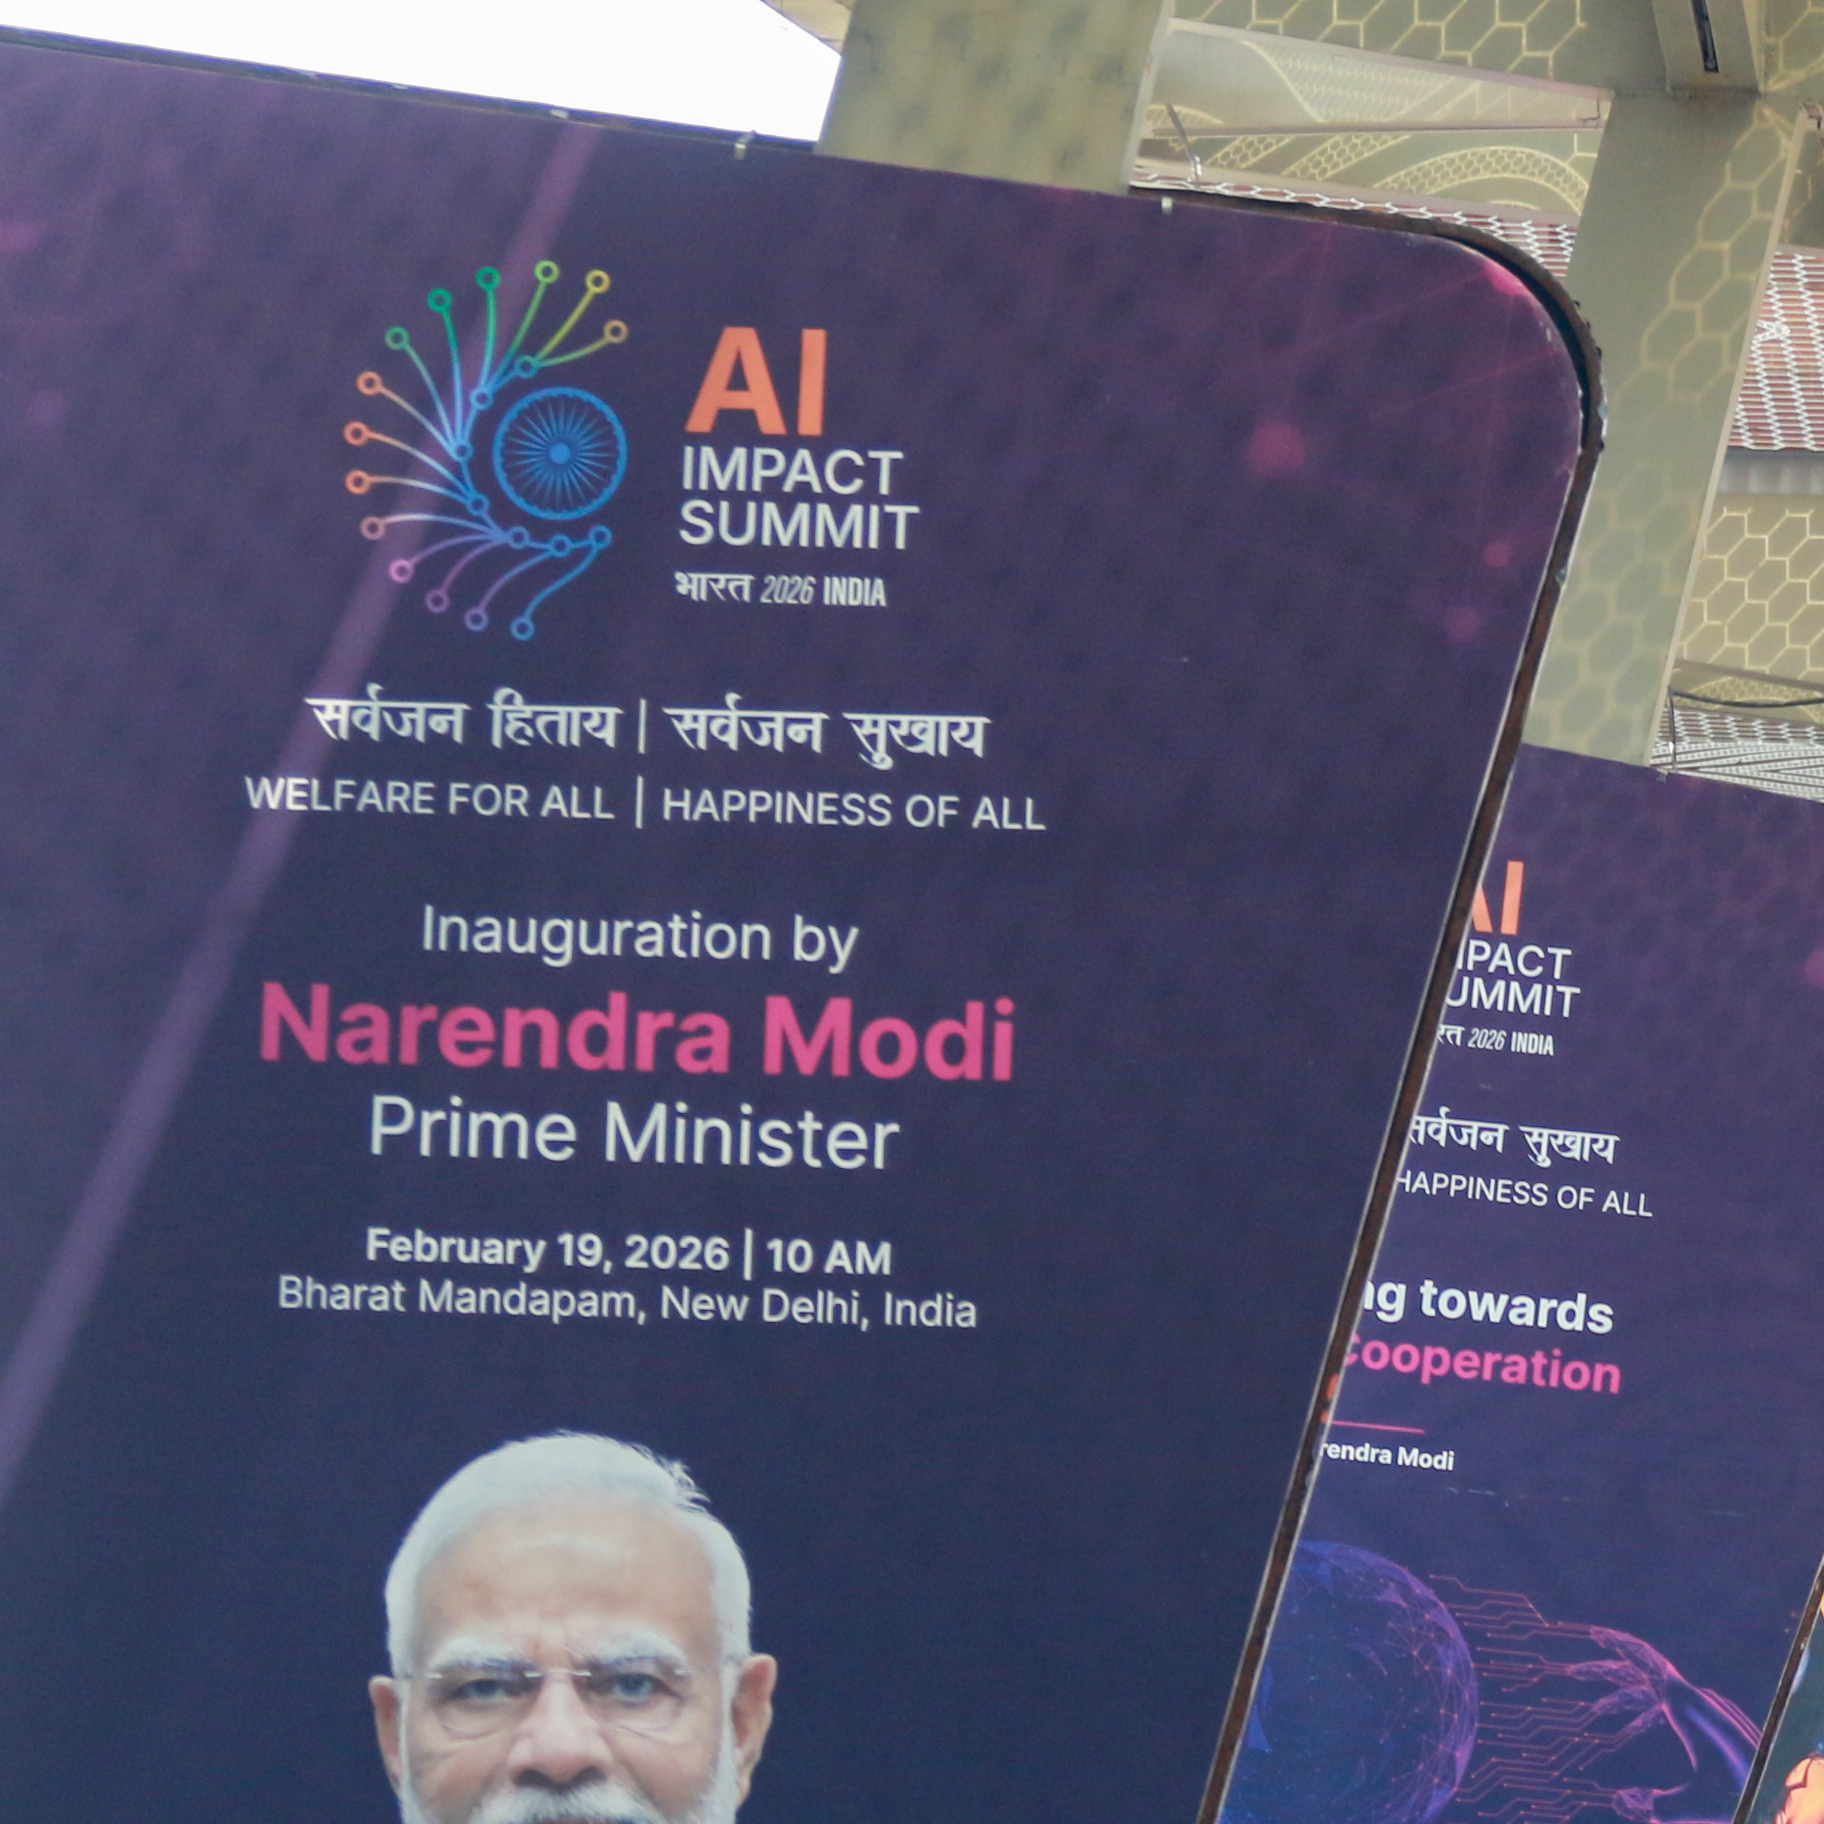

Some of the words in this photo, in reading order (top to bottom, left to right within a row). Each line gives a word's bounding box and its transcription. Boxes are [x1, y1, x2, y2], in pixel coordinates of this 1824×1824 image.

[685, 325, 827, 436] AI
[683, 445, 903, 497] IMPACT
[679, 499, 920, 550] SUMMIT
[675, 570, 755, 604] भारत
[760, 575, 815, 606] 2026
[823, 576, 887, 608] INDIA
[306, 684, 469, 743] सर्वजन
[488, 687, 623, 748] हिताय
[663, 692, 828, 754] सर्वजन
[844, 708, 991, 769] सुखाय
[246, 776, 435, 815] WELFARE
[449, 780, 528, 818] FOR
[541, 782, 615, 819] ALL
[663, 789, 892, 829] HAPPINESS
[905, 794, 958, 829] OF
[972, 796, 1046, 830] ALL
[423, 905, 771, 967] Inauguration
[793, 914, 860, 973] by
[1456, 939, 1572, 980] PACT
[260, 981, 730, 1075] Narendra
[764, 996, 1014, 1081] Modi
[1467, 1027, 1507, 1051] 2026
[1510, 1031, 1555, 1057] INDIA
[370, 1095, 577, 1162] Prime
[605, 1100, 900, 1170] Minister
[1519, 1124, 1620, 1168] सुखाय
[1556, 1185, 1596, 1211] OF
[1602, 1190, 1654, 1218] ALL
[366, 1228, 546, 1274] February
[557, 1232, 613, 1275] 19,
[625, 1234, 730, 1271] 2026
[767, 1239, 813, 1273] 10
[824, 1241, 893, 1275] AM
[278, 1275, 406, 1313] Bharat
[419, 1280, 647, 1325] Mandapam,
[661, 1288, 748, 1322] New
[761, 1290, 870, 1331] Delhi,
[884, 1293, 977, 1329] India
[1419, 1278, 1614, 1335] towards
[1397, 1446, 1455, 1472] Modi
